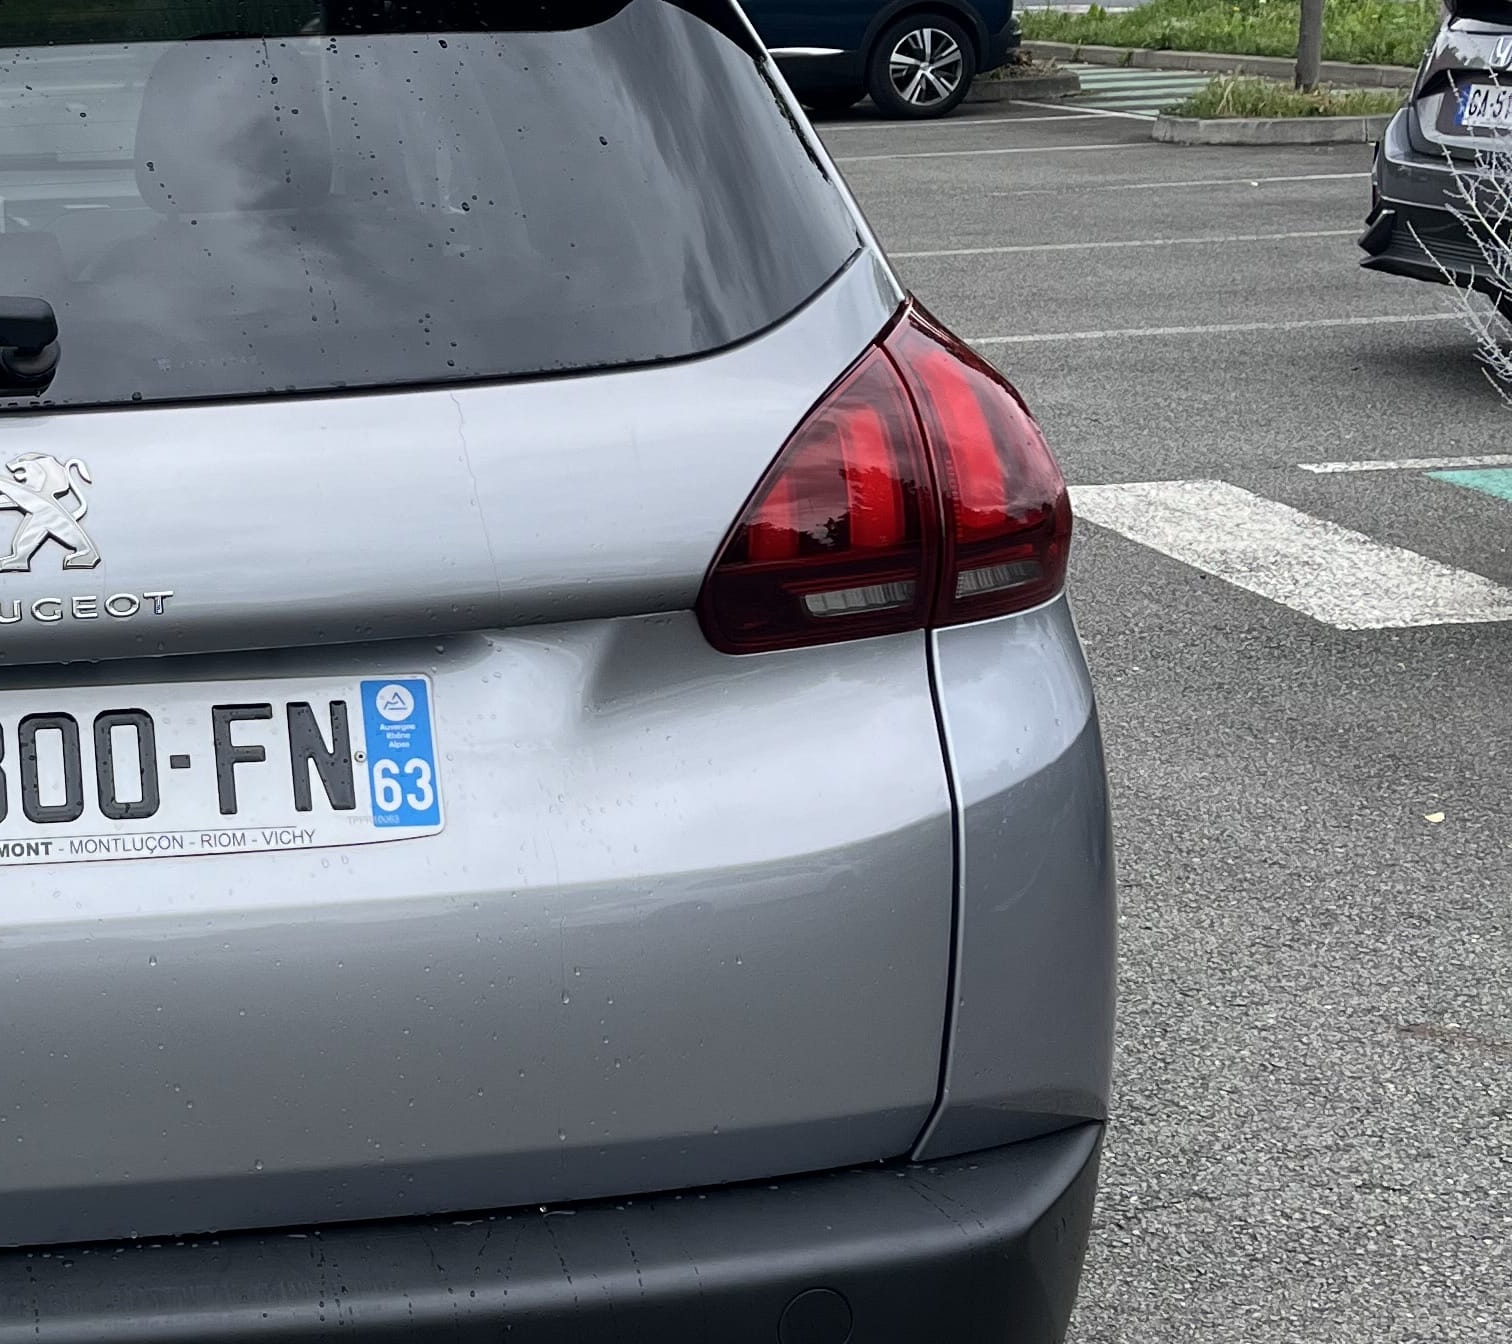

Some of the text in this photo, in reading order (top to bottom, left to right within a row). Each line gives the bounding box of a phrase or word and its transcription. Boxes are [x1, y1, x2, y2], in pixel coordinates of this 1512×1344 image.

[379, 723, 416, 732] Auvergne
[372, 757, 434, 812] 63
[69, 834, 184, 855] MONTLUÇON
[200, 832, 246, 849] RIOM
[262, 829, 316, 846] VICHY
